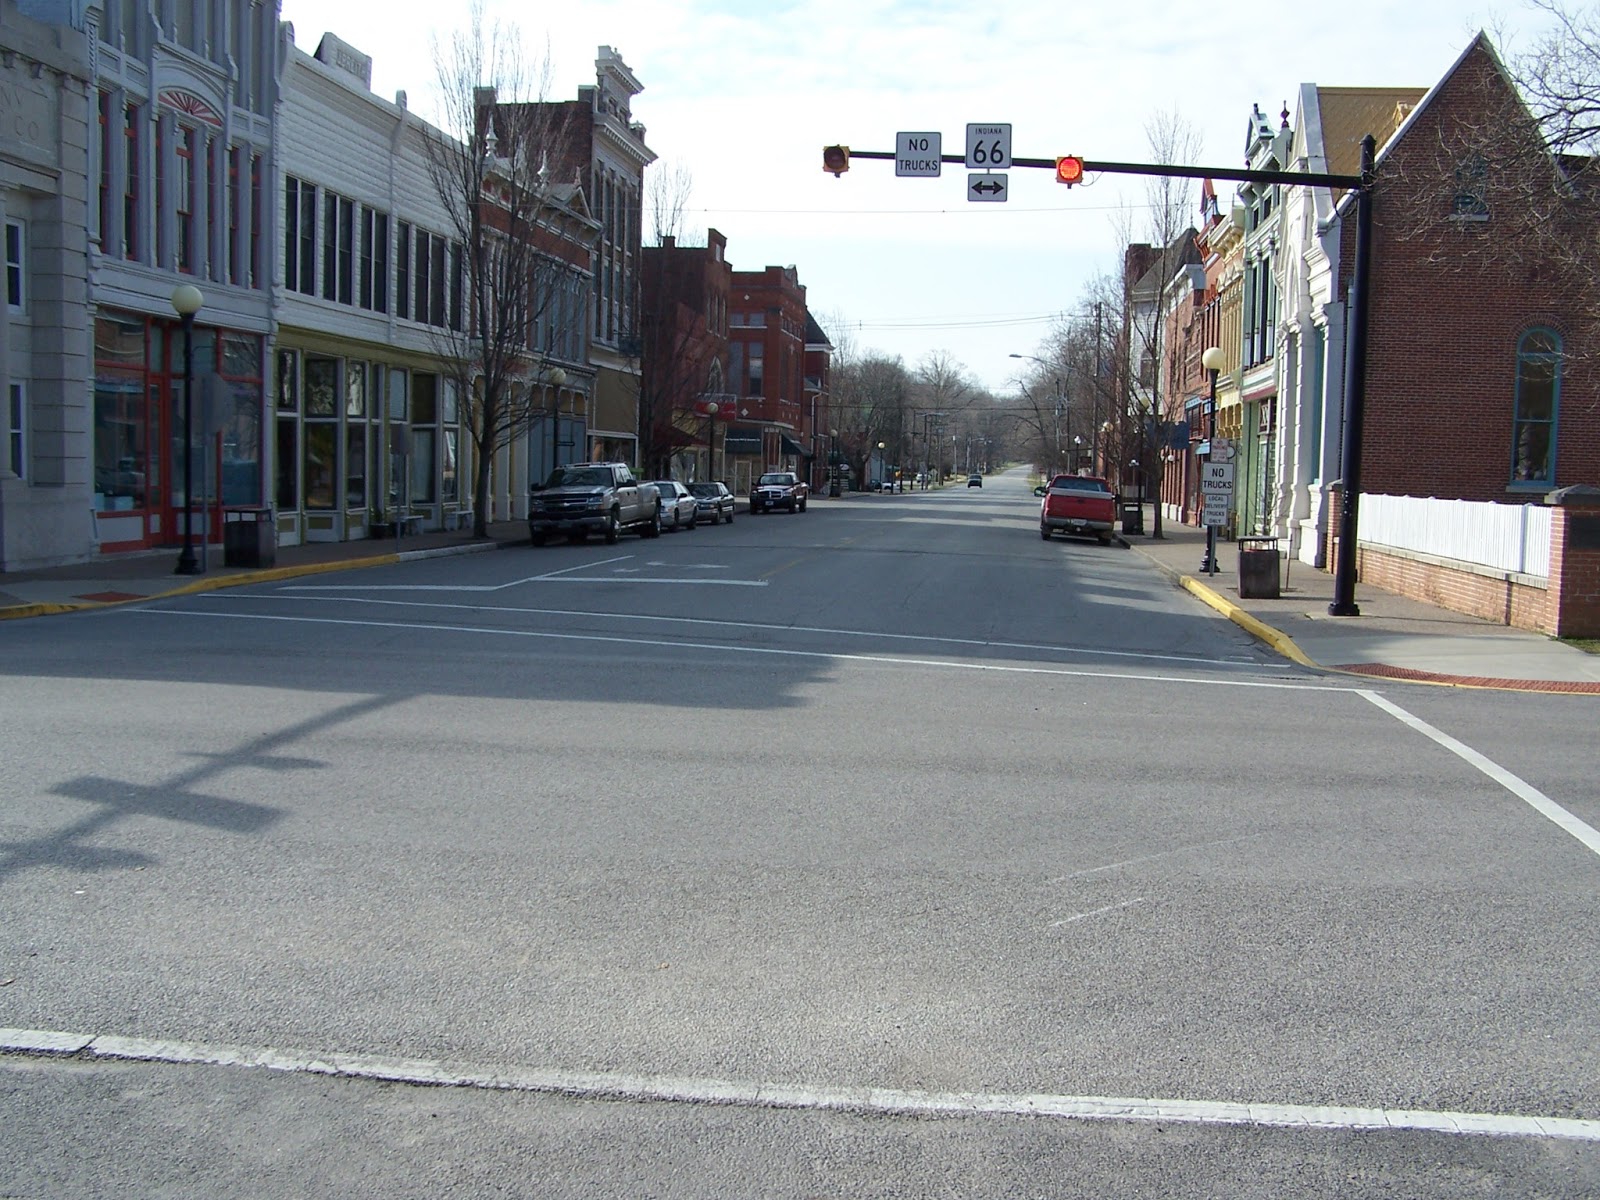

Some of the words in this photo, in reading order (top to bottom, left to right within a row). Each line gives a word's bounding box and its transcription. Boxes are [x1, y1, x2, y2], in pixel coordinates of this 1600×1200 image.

[975, 127, 1002, 135] INDIANA
[909, 138, 928, 151] NO
[974, 140, 1003, 164] 66
[899, 160, 938, 171] TRUCKS
[1212, 468, 1224, 478] NO
[1203, 480, 1232, 489] TRUCKS
